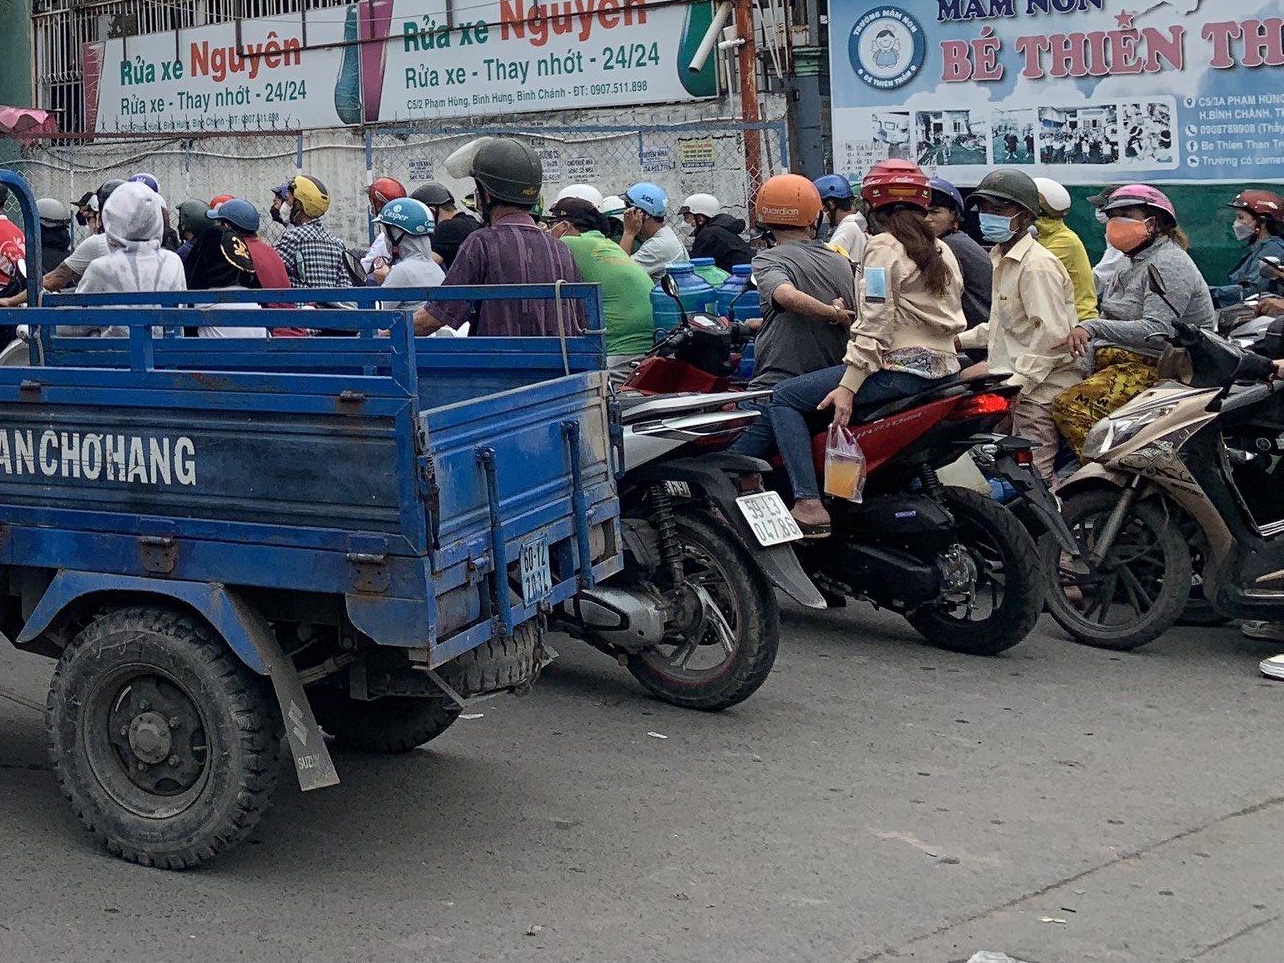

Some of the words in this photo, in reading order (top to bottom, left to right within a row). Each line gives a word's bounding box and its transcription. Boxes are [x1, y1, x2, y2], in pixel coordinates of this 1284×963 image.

[404, 15, 450, 52] Rửa
[459, 19, 489, 46] xe
[120, 55, 155, 85] Rửa
[161, 60, 183, 81] xe
[190, 31, 301, 83] Nguyên
[405, 63, 439, 89] Rửa
[446, 69, 466, 85] xe
[484, 58, 529, 84] Thay
[537, 48, 583, 77] nhớt
[602, 41, 660, 71] 24/24
[939, 25, 1004, 83] BÉ
[121, 94, 146, 115] Rửa
[150, 100, 165, 113] xe
[177, 91, 210, 113] Thay
[216, 85, 251, 107] nhớt
[266, 80, 307, 102] 24/24
[407, 99, 423, 110] C5/2
[424, 97, 446, 110] Phạm
[447, 95, 470, 108] Hùng,
[473, 93, 490, 105] Bình
[492, 91, 515, 107] Hưng,
[517, 88, 536, 101] Bình
[538, 87, 565, 99] Chánh
[573, 85, 588, 97] ĐT:
[590, 80, 647, 96] 0907.511.898
[1227, 95, 1256, 107] PHẠM
[383, 208, 409, 221] Casper
[761, 206, 799, 215] guardian
[745, 496, 782, 519] 59-L3
[754, 517, 798, 542] 047.86
[297, 753, 322, 770] SUZUK
